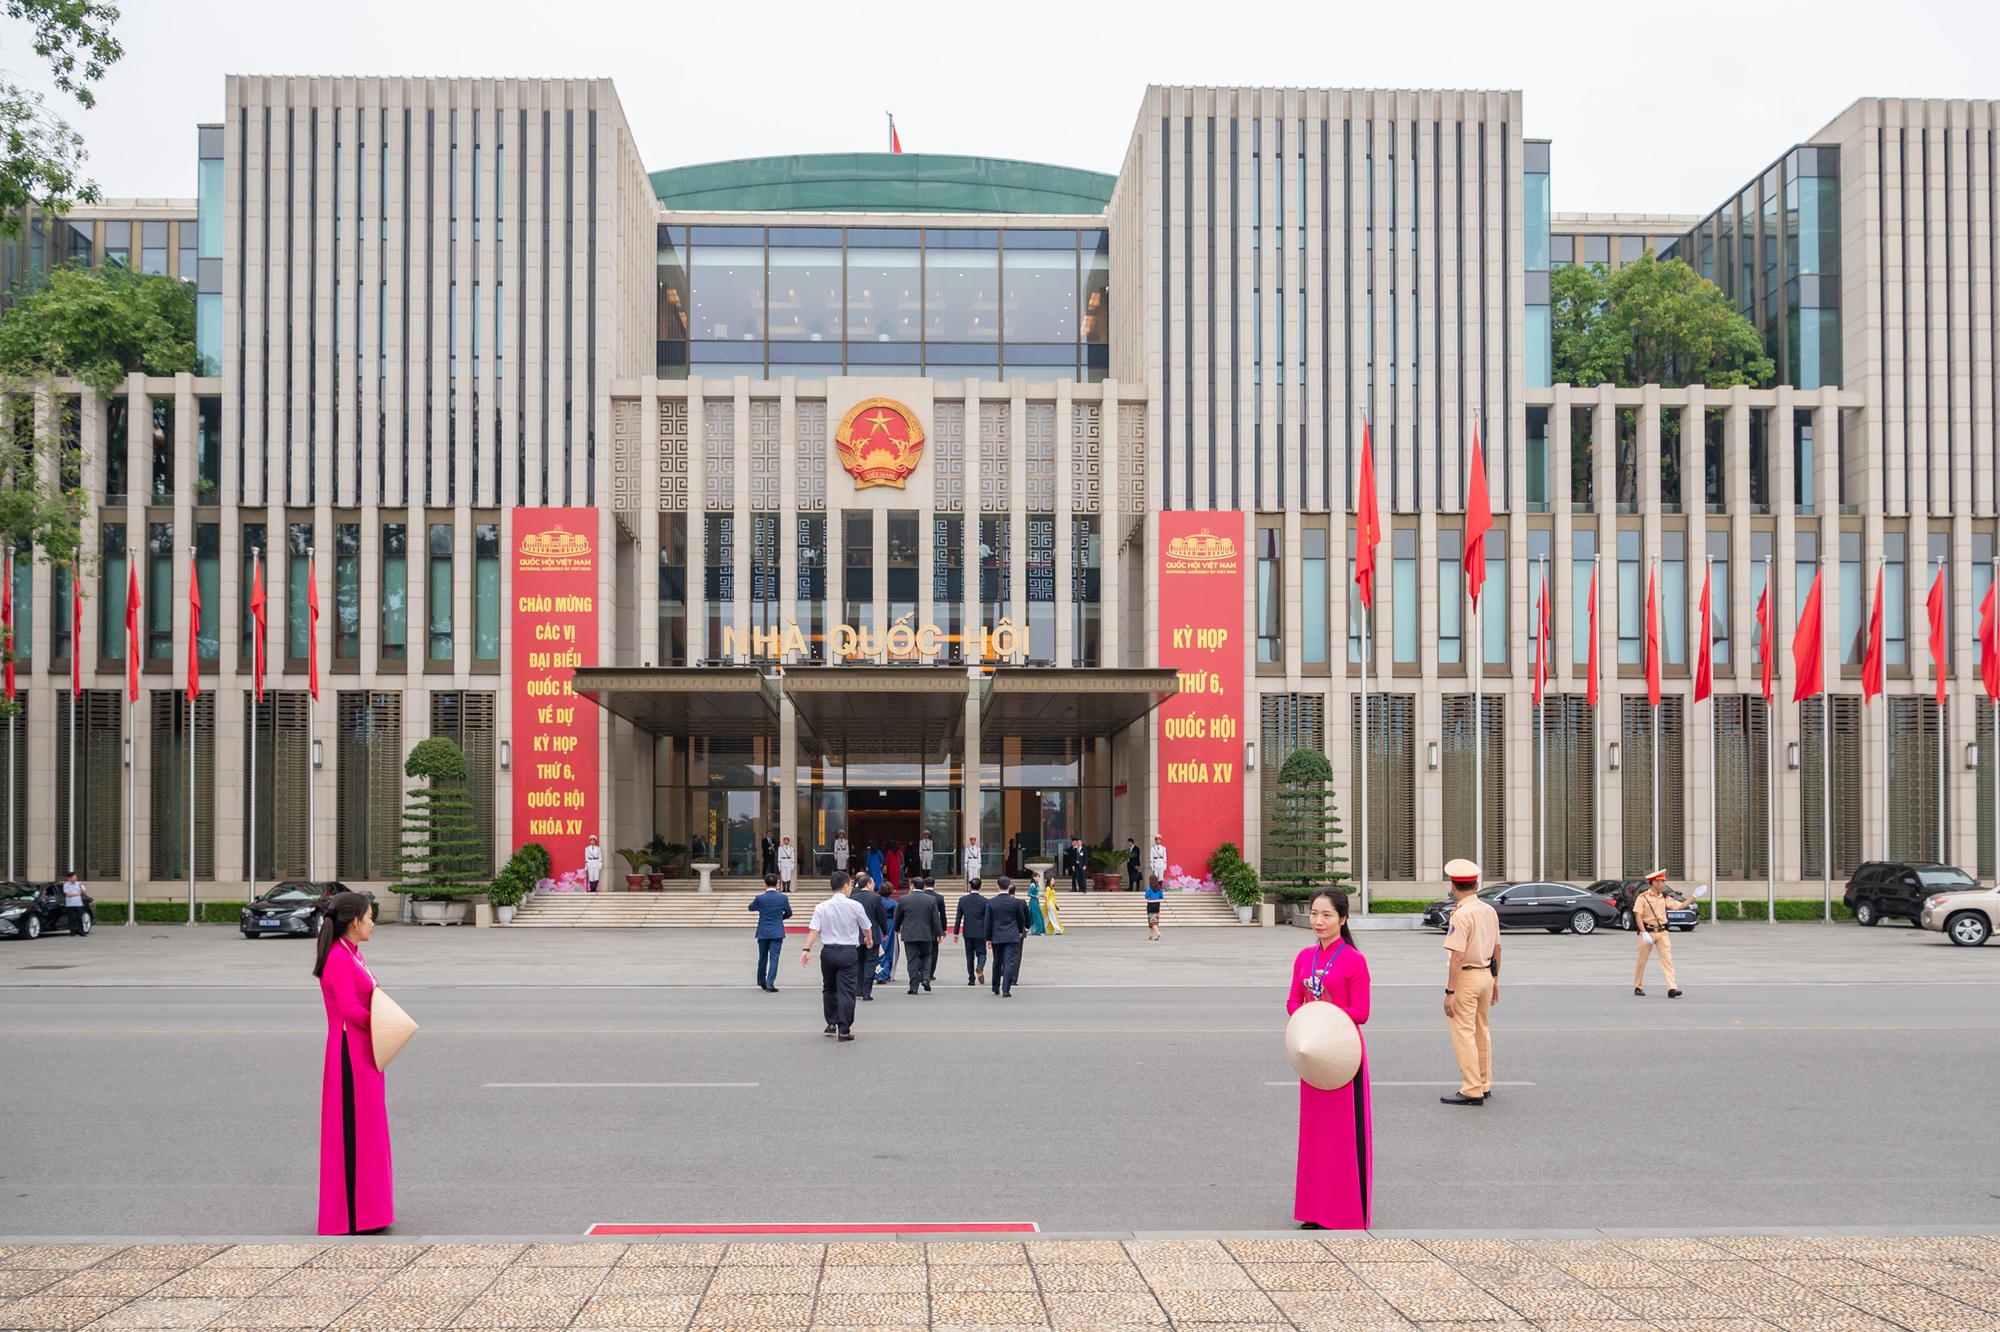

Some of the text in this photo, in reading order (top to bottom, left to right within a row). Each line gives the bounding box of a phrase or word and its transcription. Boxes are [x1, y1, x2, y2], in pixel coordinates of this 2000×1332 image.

[519, 557, 591, 567] QUỐC HỘI VIỆT NAM
[1165, 560, 1186, 569] QUỐC
[1187, 560, 1201, 570] HỘI
[1201, 561, 1219, 570] VIỆT
[518, 594, 593, 613] CHÀO MỪNG
[535, 621, 576, 644] CÁC VỊ
[723, 611, 1030, 663] NHÀ QUỐC HỘI
[1173, 624, 1229, 653] KỲ HỌP
[529, 646, 582, 672] ĐẠI BIỂU
[526, 675, 561, 698] QUỐC
[1176, 668, 1225, 696] THỨ 6,
[537, 703, 575, 727] VỀ DỰ
[1164, 710, 1236, 743] QUỐC HỘI
[533, 732, 578, 755] KỲ HỌP
[536, 761, 575, 781] THỨ 6,
[1167, 758, 1233, 784] KHÓA XV
[527, 787, 585, 811] QUỐC HỘI
[530, 816, 583, 835] KHÓA XV
